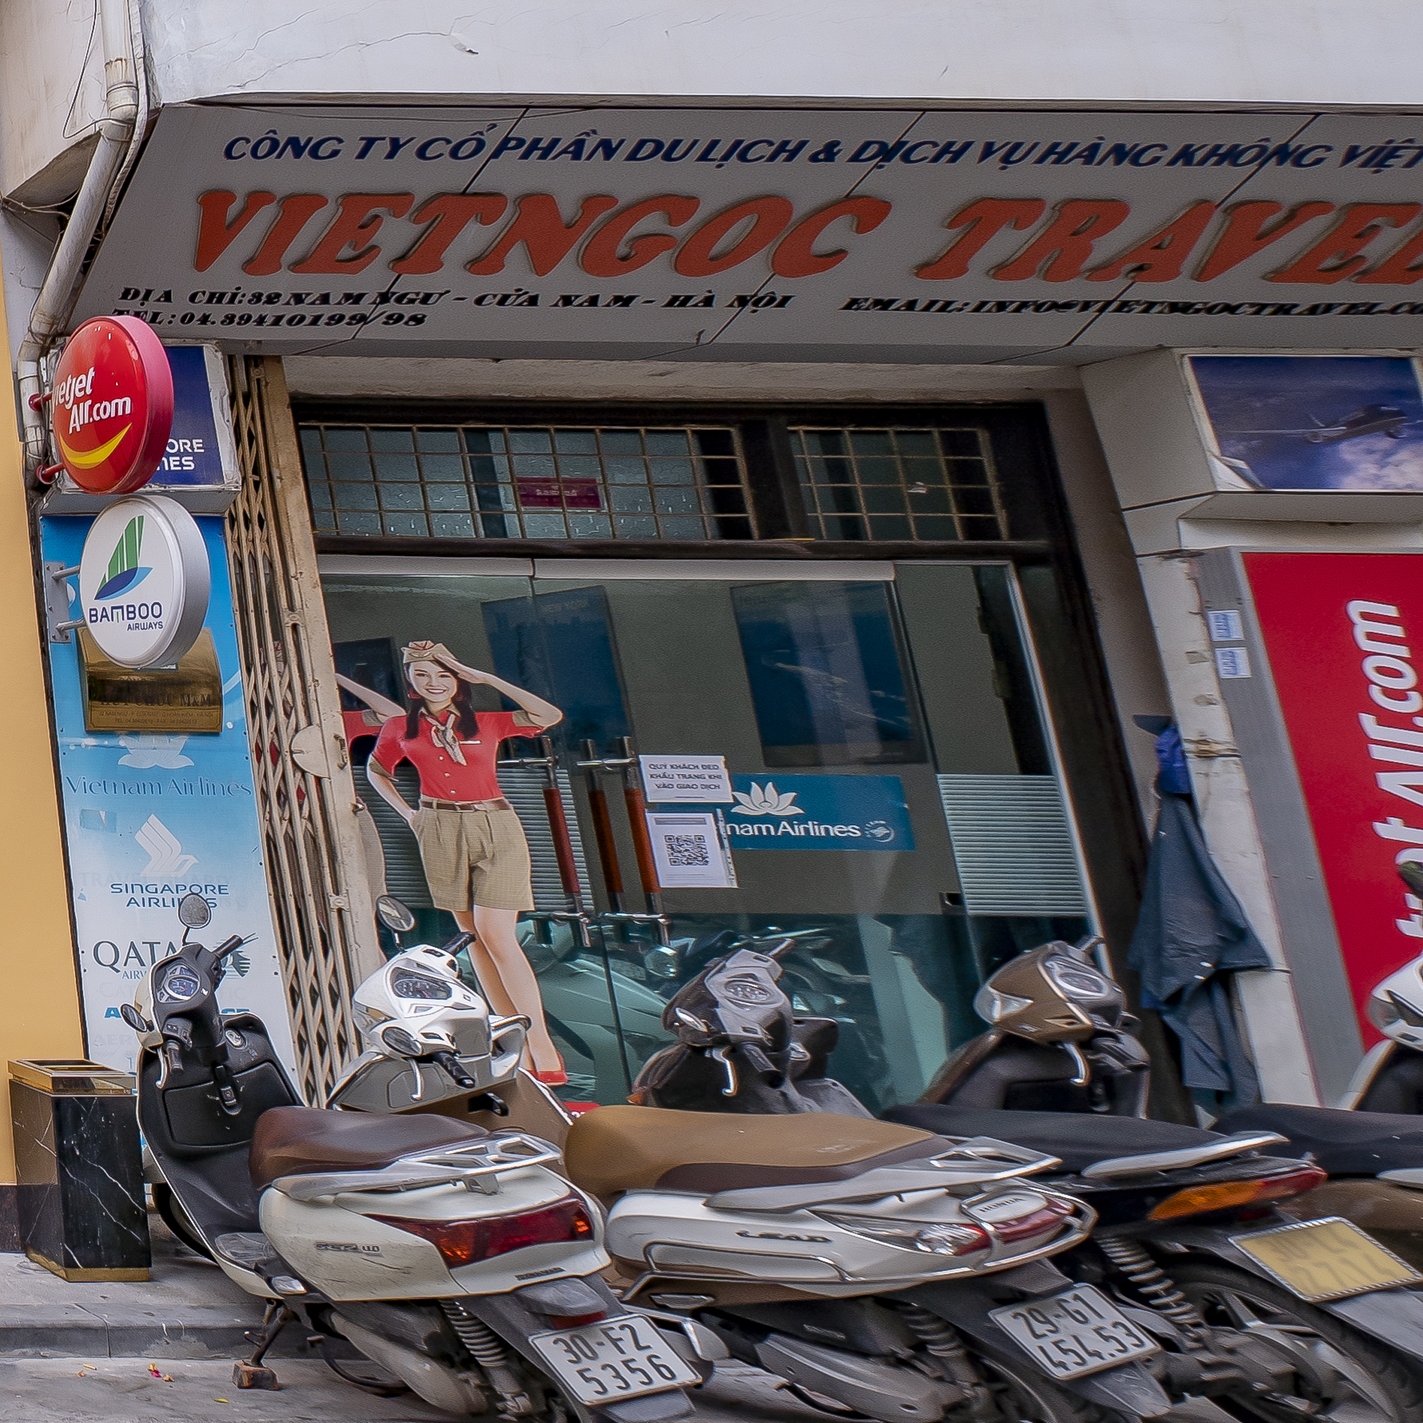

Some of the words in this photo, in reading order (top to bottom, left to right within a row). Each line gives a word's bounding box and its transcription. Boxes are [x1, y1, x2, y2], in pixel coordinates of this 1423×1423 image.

[224, 129, 344, 161] CÔNG
[357, 136, 415, 161] TY
[415, 123, 498, 161] CỔ
[495, 129, 633, 162] PHẦN
[633, 137, 694, 163] DU
[694, 137, 813, 167] LỊCH
[811, 139, 843, 163] &
[850, 139, 973, 168] DỊCH
[979, 139, 1033, 171] VỤ
[1032, 135, 1164, 166] HÀNG
[1164, 137, 1334, 168] KHÔNG
[194, 189, 892, 279] VIETNGOC
[119, 287, 173, 306] ĐỊA
[282, 292, 369, 305] NAM
[549, 294, 641, 308] NAM
[661, 290, 716, 308] HÀ
[724, 291, 797, 313] NỘI
[89, 601, 163, 624] BAMBOO
[126, 621, 163, 632] AIRWAYS
[66, 776, 162, 796] Vietnam
[167, 777, 253, 797] Airlines
[777, 821, 862, 837] Airlines
[110, 882, 229, 895] SINGAPORE
[126, 897, 218, 909] AIRLIS
[93, 940, 181, 973] QATA
[1010, 1293, 1106, 1340] 29-G1
[552, 1324, 653, 1364] 30-F2
[1037, 1321, 1145, 1371] 454.53
[576, 1354, 678, 1395] 5356
